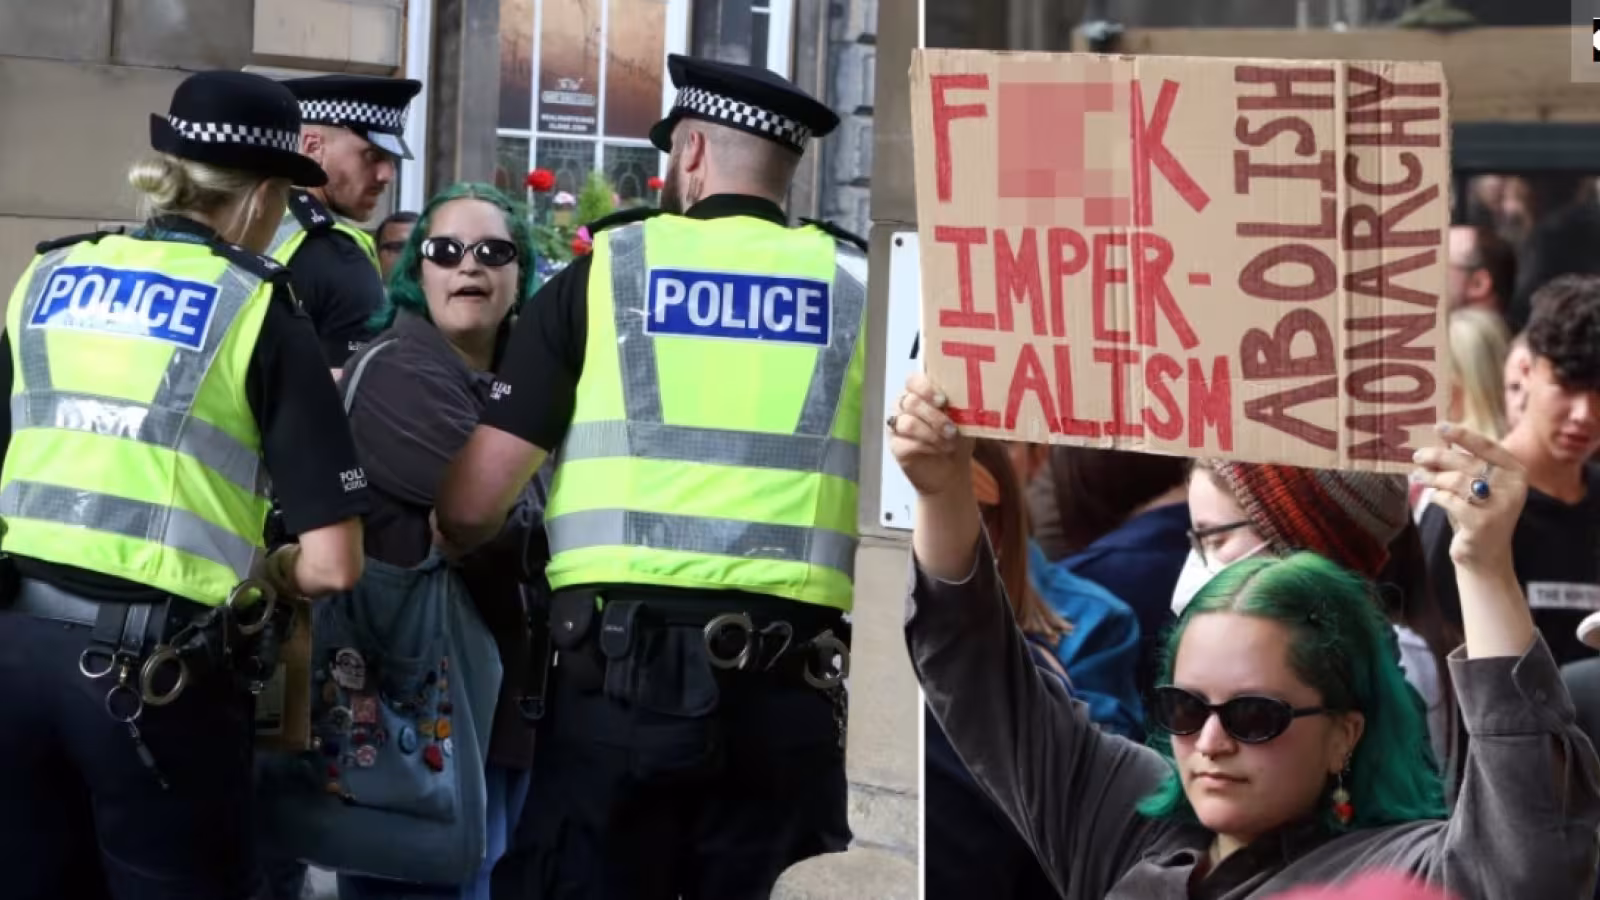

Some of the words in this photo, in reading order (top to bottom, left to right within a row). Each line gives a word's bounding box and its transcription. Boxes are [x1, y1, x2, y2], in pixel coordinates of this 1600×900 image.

[930, 73, 1211, 226] FK
[39, 273, 207, 336] POLICE
[654, 277, 822, 335] POLICE
[934, 226, 1212, 350] IMPER-
[1234, 65, 1338, 451] ABOLISH
[1343, 65, 1442, 463] MONARCHY
[941, 341, 1234, 452] IALISM
